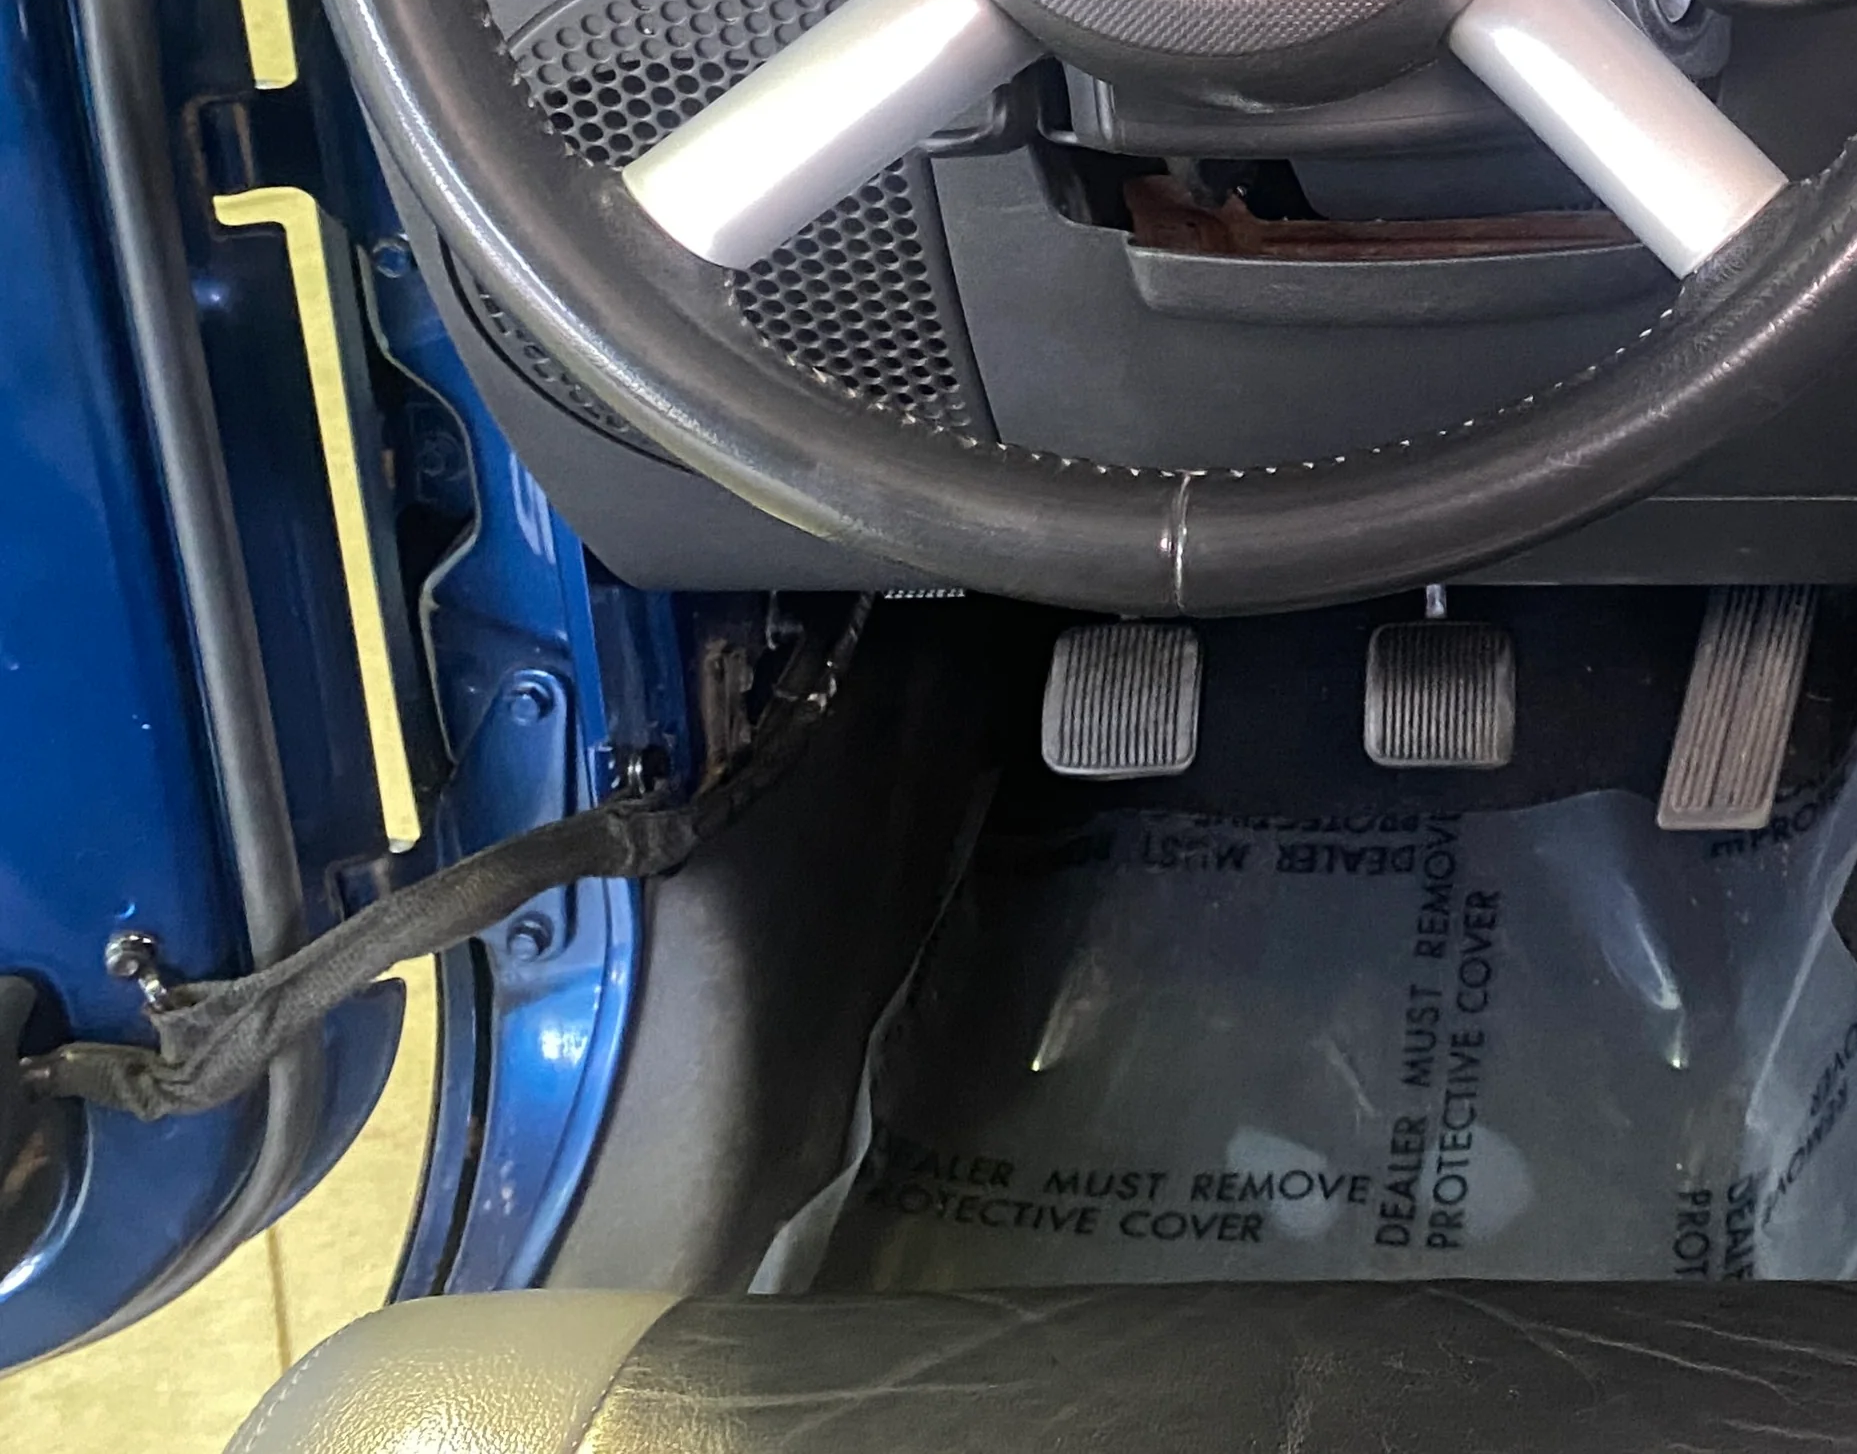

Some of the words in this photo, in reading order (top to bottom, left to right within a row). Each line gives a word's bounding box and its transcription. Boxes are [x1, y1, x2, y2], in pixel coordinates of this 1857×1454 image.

[1275, 843, 1415, 875] DEALER
[1400, 983, 1443, 1089] MUST
[1425, 1030, 1485, 1251] PROTECTIVE
[1455, 888, 1501, 1015] COVER
[1043, 1169, 1168, 1202] MUST
[1189, 1168, 1372, 1204] REMOVE
[1375, 1114, 1428, 1247] DEALER
[1118, 1209, 1265, 1244] COVER
